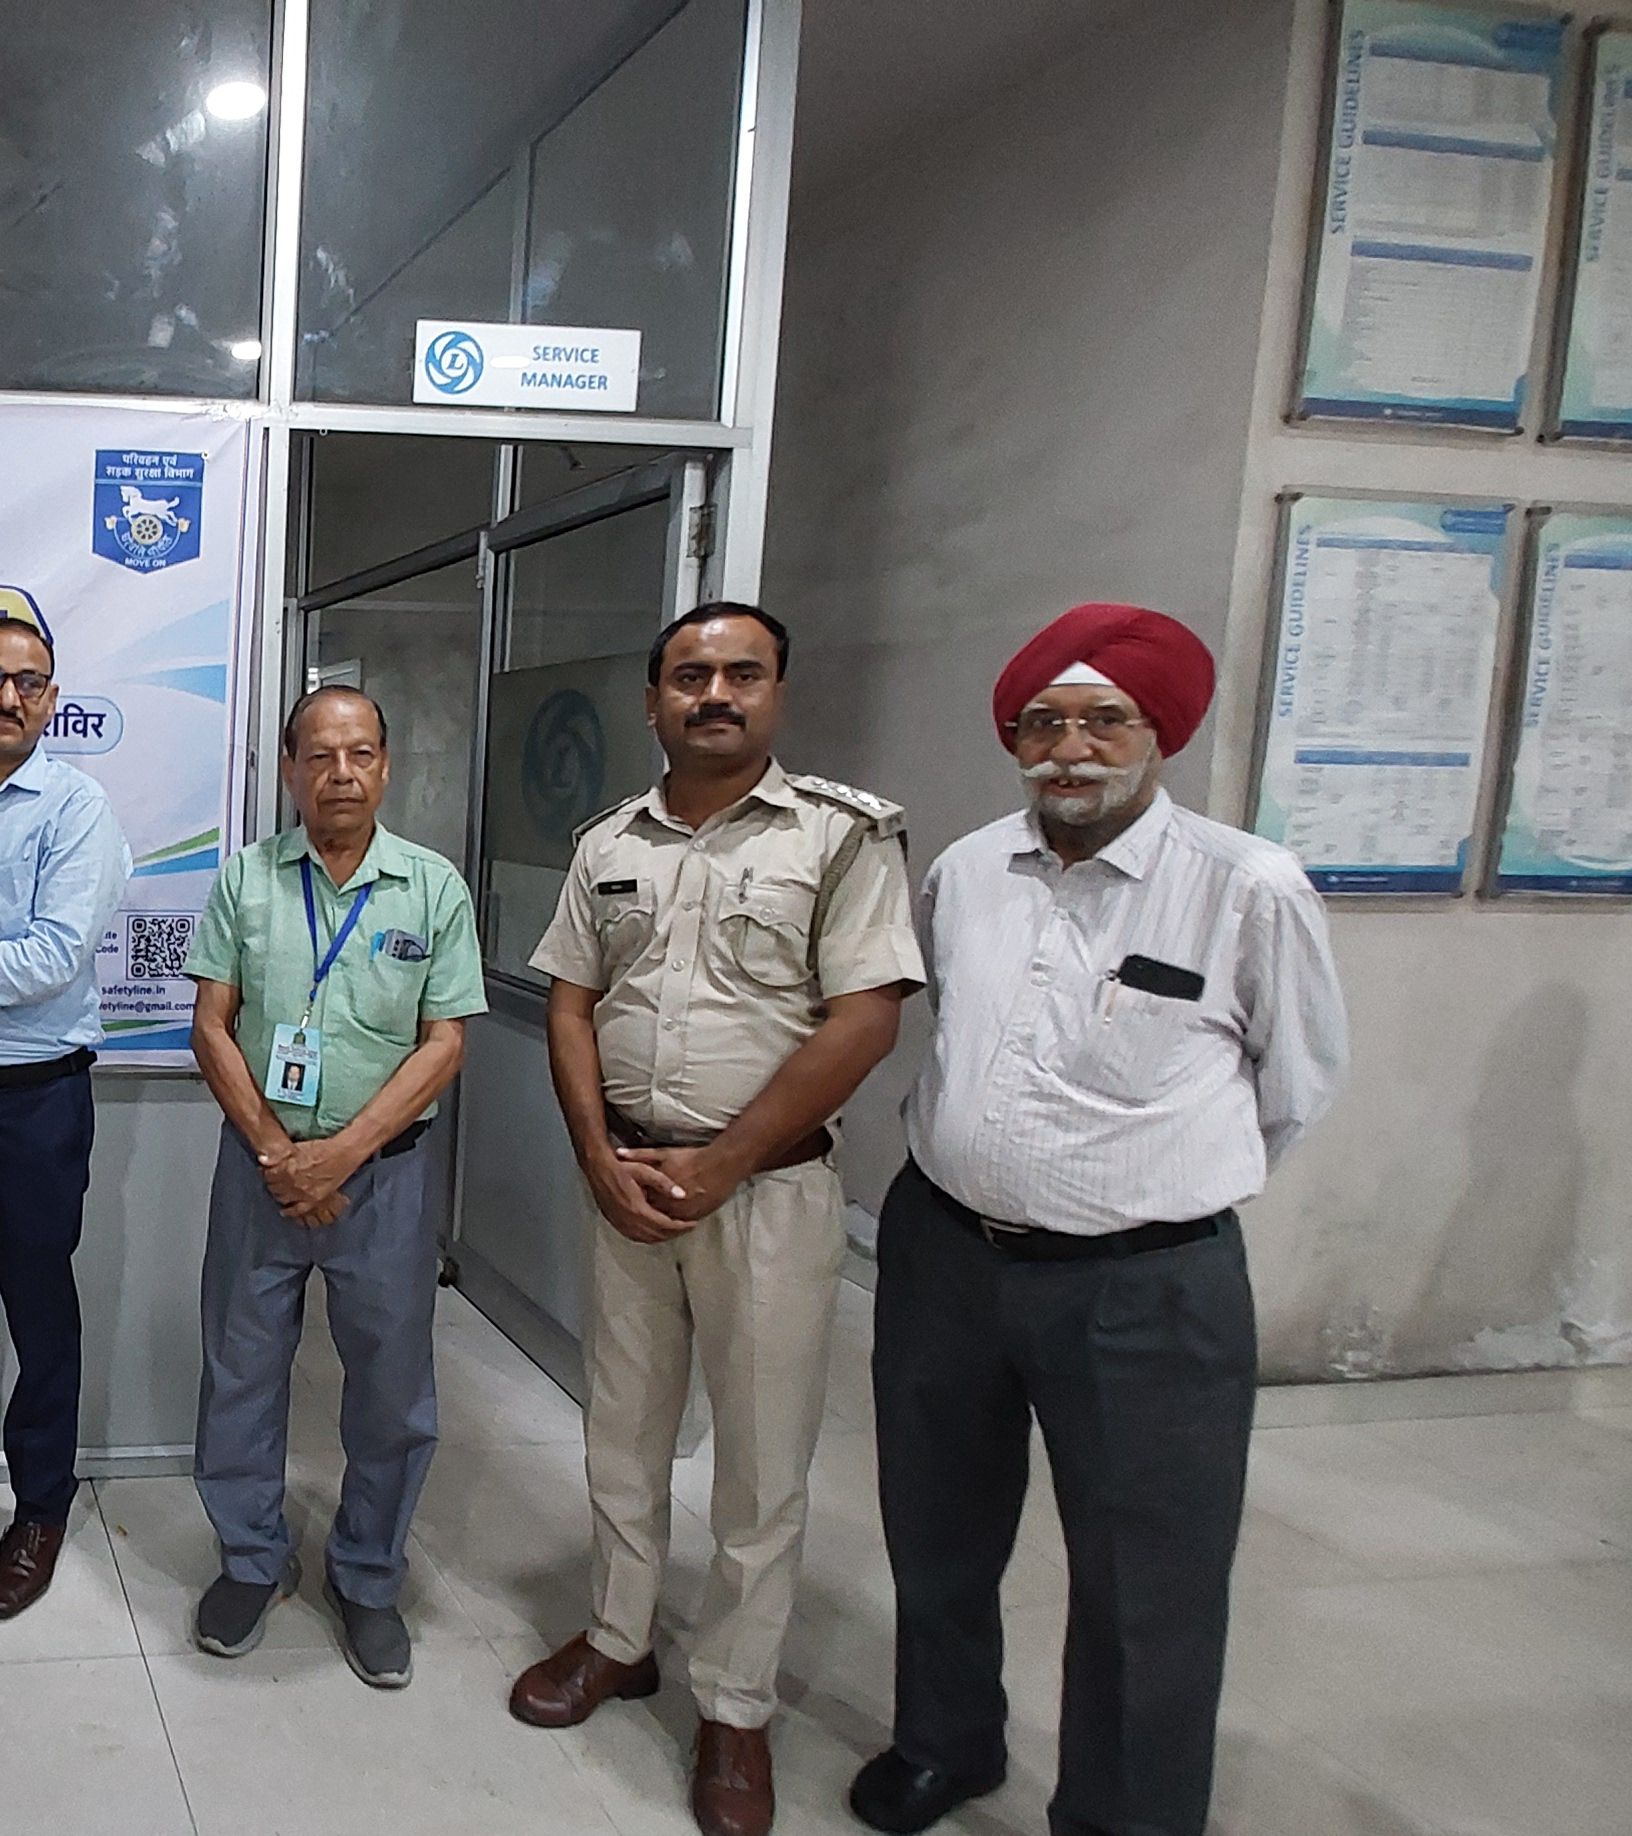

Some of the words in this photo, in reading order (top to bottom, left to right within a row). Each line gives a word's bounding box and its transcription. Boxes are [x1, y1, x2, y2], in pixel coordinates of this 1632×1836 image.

[533, 345, 599, 364] SERVICE
[521, 371, 608, 391] MANAGER
[124, 558, 150, 568] MOVE
[152, 559, 167, 568] ON
[1289, 523, 1313, 638] GUIDELINES
[1278, 642, 1302, 718] SERVICE
